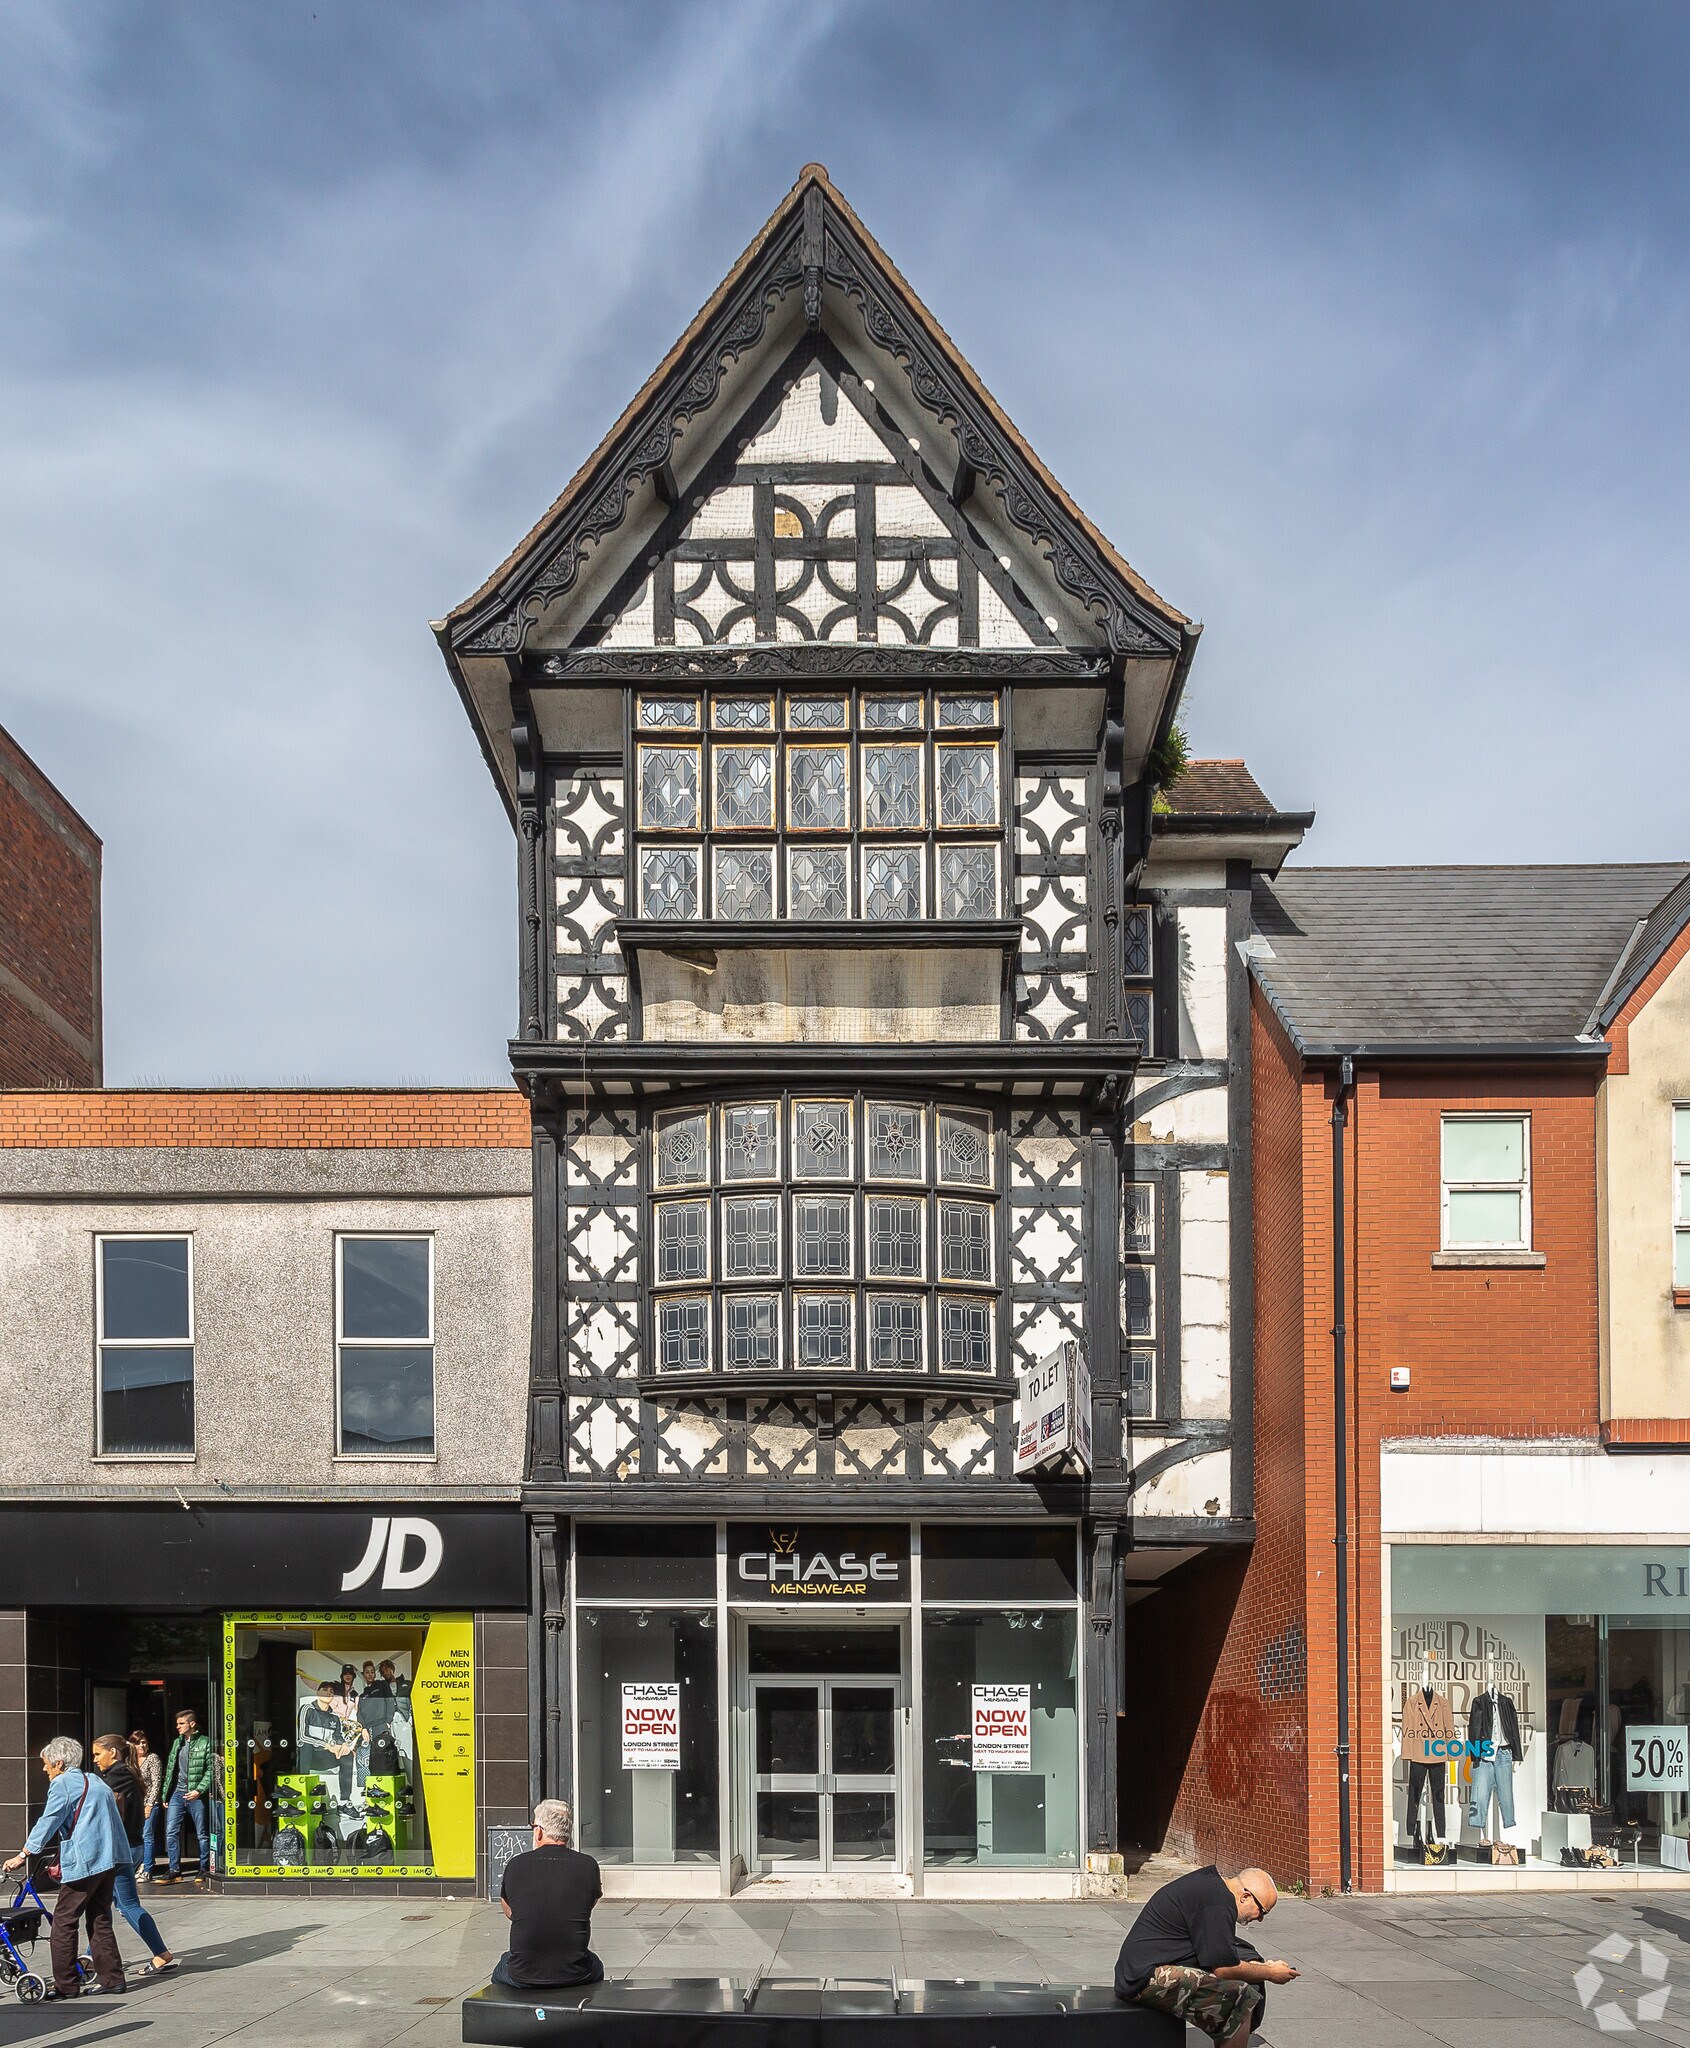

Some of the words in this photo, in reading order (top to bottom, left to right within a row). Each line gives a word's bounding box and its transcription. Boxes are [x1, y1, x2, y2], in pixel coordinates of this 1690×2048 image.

[1028, 1377, 1040, 1402] TO
[1043, 1361, 1059, 1392] LET
[340, 1516, 444, 1591] JD
[738, 1552, 899, 1581] CHASE
[771, 1583, 867, 1594] MENSWEAR
[436, 1660, 470, 1668] WOMEN
[623, 1686, 678, 1696] CHASE
[973, 1687, 1028, 1697] CHASE
[626, 1708, 676, 1721] NOW
[976, 1710, 1026, 1723] NOW
[625, 1723, 676, 1735] OPEN
[975, 1725, 1027, 1736] OPEN
[1394, 1727, 1462, 1739] Wardrobe
[1424, 1739, 1494, 1757] ICONS
[1631, 1739, 1683, 1778] 30%
[1668, 1765, 1683, 1778] OFF
